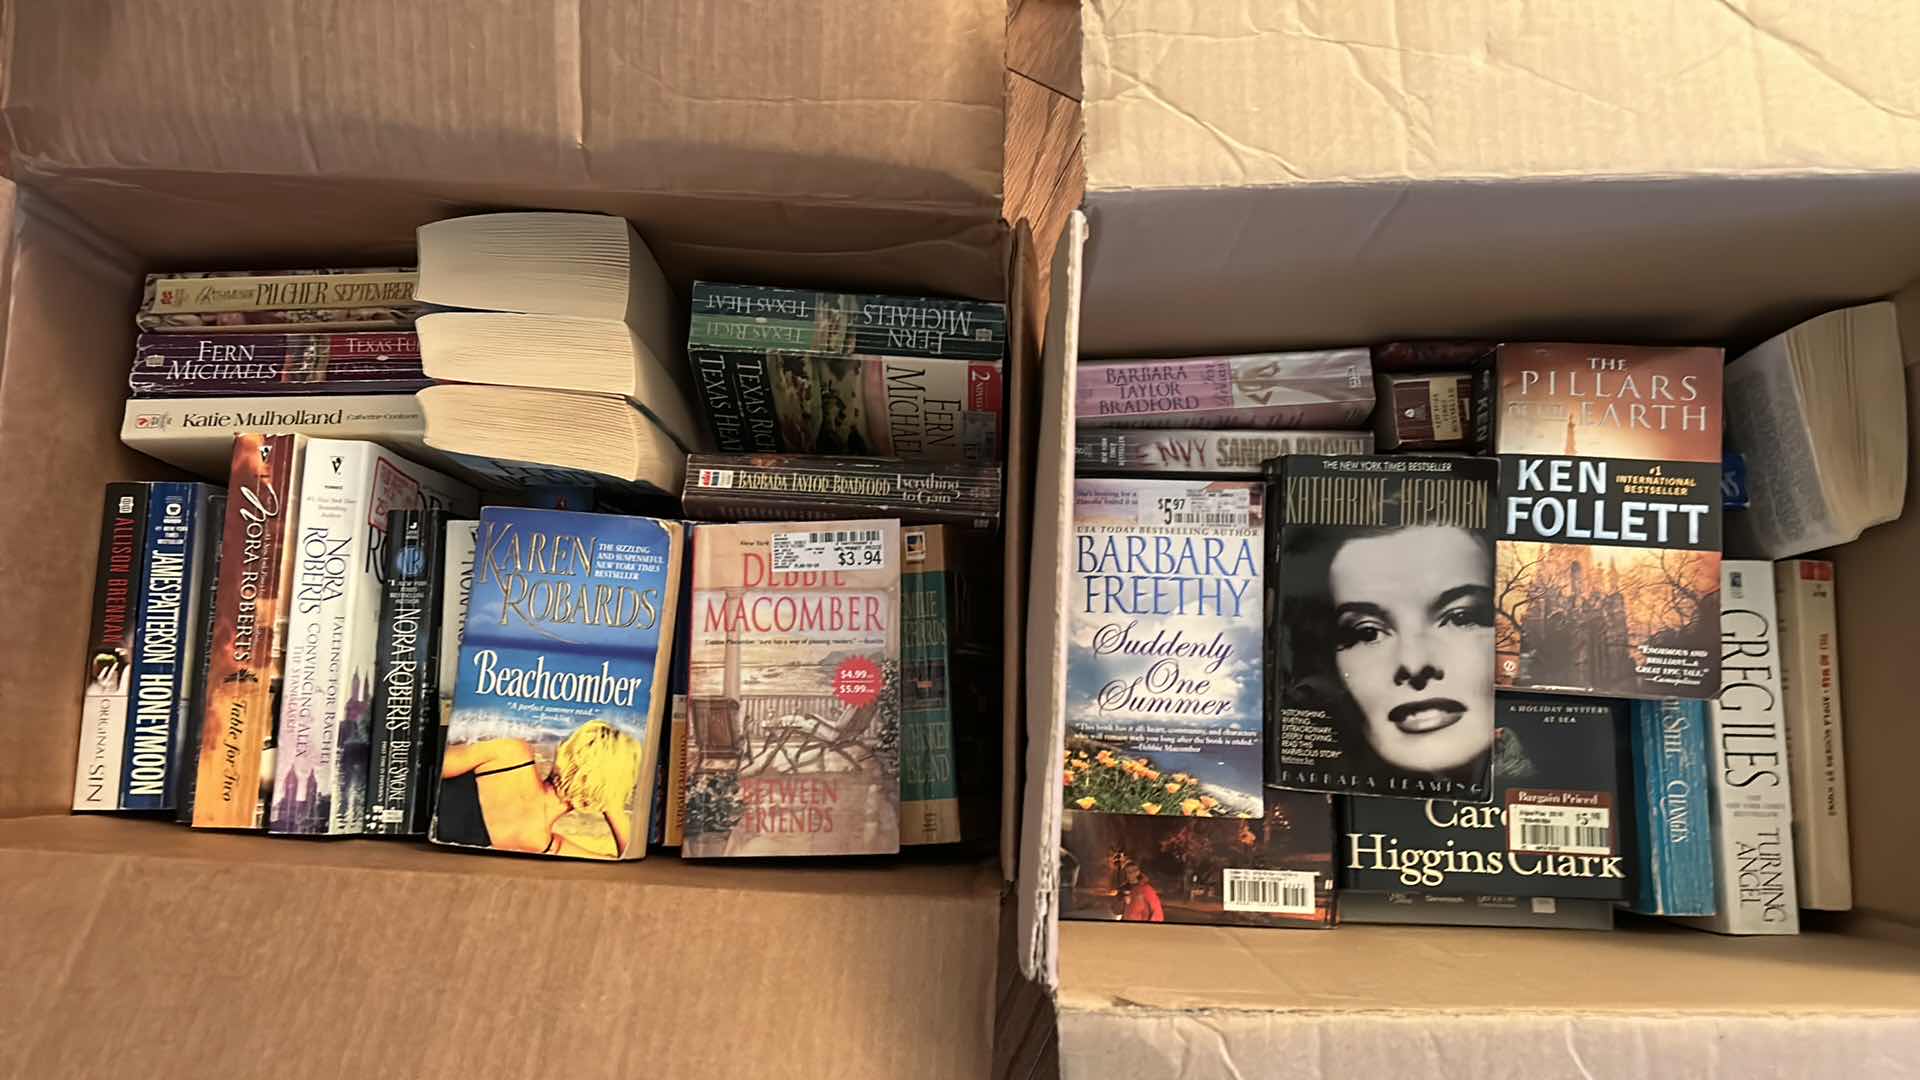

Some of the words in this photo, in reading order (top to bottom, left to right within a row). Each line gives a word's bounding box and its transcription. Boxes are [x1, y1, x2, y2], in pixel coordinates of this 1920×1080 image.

[255, 281, 328, 306] PILCHER
[334, 281, 414, 302] SEPTEMBER
[705, 294, 754, 314] HEAT
[756, 297, 808, 318] TEXAS
[752, 324, 802, 343] TEXAS
[863, 303, 973, 336] MICHAELS
[197, 340, 255, 361] FERN
[346, 337, 393, 353] TEXAS
[887, 329, 944, 354] FERN
[166, 359, 277, 381] MICHAELS
[972, 369, 991, 382] 2
[1106, 366, 1187, 384] BARBARA
[1587, 357, 1627, 370] THE
[699, 355, 731, 408] TEXAS
[736, 359, 769, 414] TEXAS
[1118, 381, 1181, 400] TAYLOR
[1520, 370, 1698, 402] PILLARS
[183, 413, 231, 429] Katie
[235, 409, 343, 428] Mulholland
[1099, 394, 1199, 415] BRADFORD
[1579, 401, 1708, 432] EARTH
[924, 399, 961, 448] FERN
[1216, 438, 1288, 468] SANDRA
[1322, 460, 1338, 470] THE
[1339, 461, 1358, 471] NEW
[1361, 461, 1382, 472] YORK
[1384, 461, 1406, 472] TIMES
[1408, 462, 1452, 472] BESTSELLER
[832, 474, 891, 496] BRADFORD
[1517, 459, 1608, 495] KEN
[1615, 474, 1697, 487] INTERNATIONAL
[1648, 465, 1662, 476] #1
[1285, 476, 1388, 526] KATHARINE
[1401, 478, 1488, 529] HEPBURN
[1624, 484, 1690, 496] BESTSELLER
[239, 482, 280, 564] NORA
[1076, 526, 1096, 534] USA
[1100, 526, 1136, 534] TODAY
[1138, 527, 1209, 536] BESTSELLING
[1213, 528, 1258, 537] AUTHOR
[1505, 496, 1710, 545] FOLLETT
[109, 518, 135, 573] ALLISON
[479, 521, 598, 588] KAREN
[597, 552, 614, 561] AND
[598, 543, 614, 552] THE
[616, 544, 651, 554] SIZZLING
[838, 551, 882, 567] $3.94
[1077, 535, 1258, 576] BARBARA
[150, 550, 184, 591] JAMES
[296, 526, 329, 615] ROBERTS
[322, 537, 352, 602] NORA
[594, 570, 640, 580] BESTSELLER
[596, 561, 612, 570] NEW
[615, 562, 636, 572] YORK
[638, 563, 660, 573] TIMES
[103, 578, 128, 644] BRENNAN
[500, 572, 657, 632] ROBARDS
[1083, 575, 1250, 617] FREETHY
[142, 592, 181, 664] PATTERSON
[232, 571, 261, 661] ROBERTS
[391, 607, 422, 655] NORA
[704, 596, 886, 633] MACOMBER
[327, 615, 346, 673] FALLING
[1092, 620, 1234, 673] Suddenly
[1719, 608, 1775, 712] GREG
[298, 622, 321, 718] CONVINCING
[473, 650, 642, 707] Beachcomber
[840, 669, 867, 679] $4.99
[1145, 658, 1211, 695] One
[325, 677, 341, 706] FOR
[384, 661, 417, 731] ROBERTS
[839, 684, 866, 694] $5.99
[1098, 676, 1232, 717] Summer
[227, 699, 248, 740] Table
[1518, 705, 1562, 713] HOLIDAY
[1566, 706, 1609, 714] MYSTERY
[94, 698, 111, 761] ORIGINAL
[129, 674, 174, 795] HONEYMOON
[294, 723, 312, 759] ALEX
[319, 711, 337, 766] RACHEL
[223, 741, 241, 768] for
[390, 740, 411, 765] BLUE
[1721, 723, 1780, 789] ILES
[86, 763, 107, 803] SIN
[222, 772, 239, 802] Two
[387, 765, 408, 801] SMOKE
[740, 779, 838, 805] BETWEEN
[1281, 770, 1376, 788] BARBARA
[1389, 776, 1483, 793] LEAMING
[1518, 790, 1560, 805] Bargain
[1561, 792, 1599, 806] Priced
[744, 807, 832, 833] FRIENDS
[1345, 833, 1504, 887] Higgins
[1735, 841, 1762, 909] ANGEL
[1757, 829, 1787, 923] TURNING
